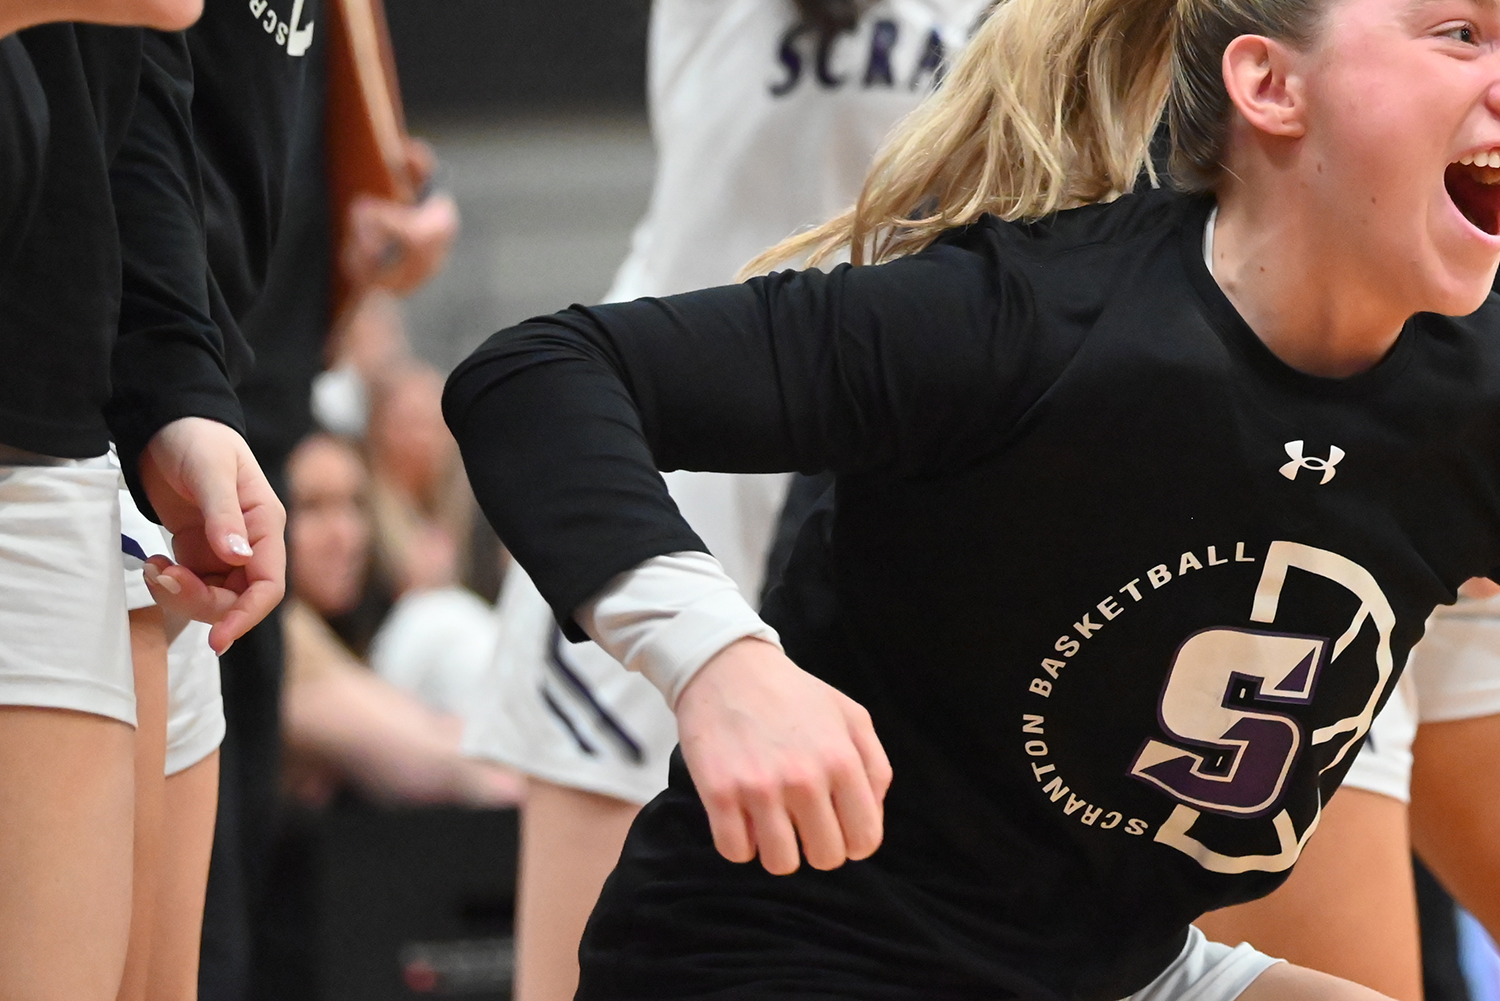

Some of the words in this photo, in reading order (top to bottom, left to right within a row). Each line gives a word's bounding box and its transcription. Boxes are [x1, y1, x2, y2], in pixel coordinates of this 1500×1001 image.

[1029, 541, 1255, 698] BASKETBALL
[1022, 713, 1149, 836] SCRANTON
[1125, 625, 1330, 819] S
